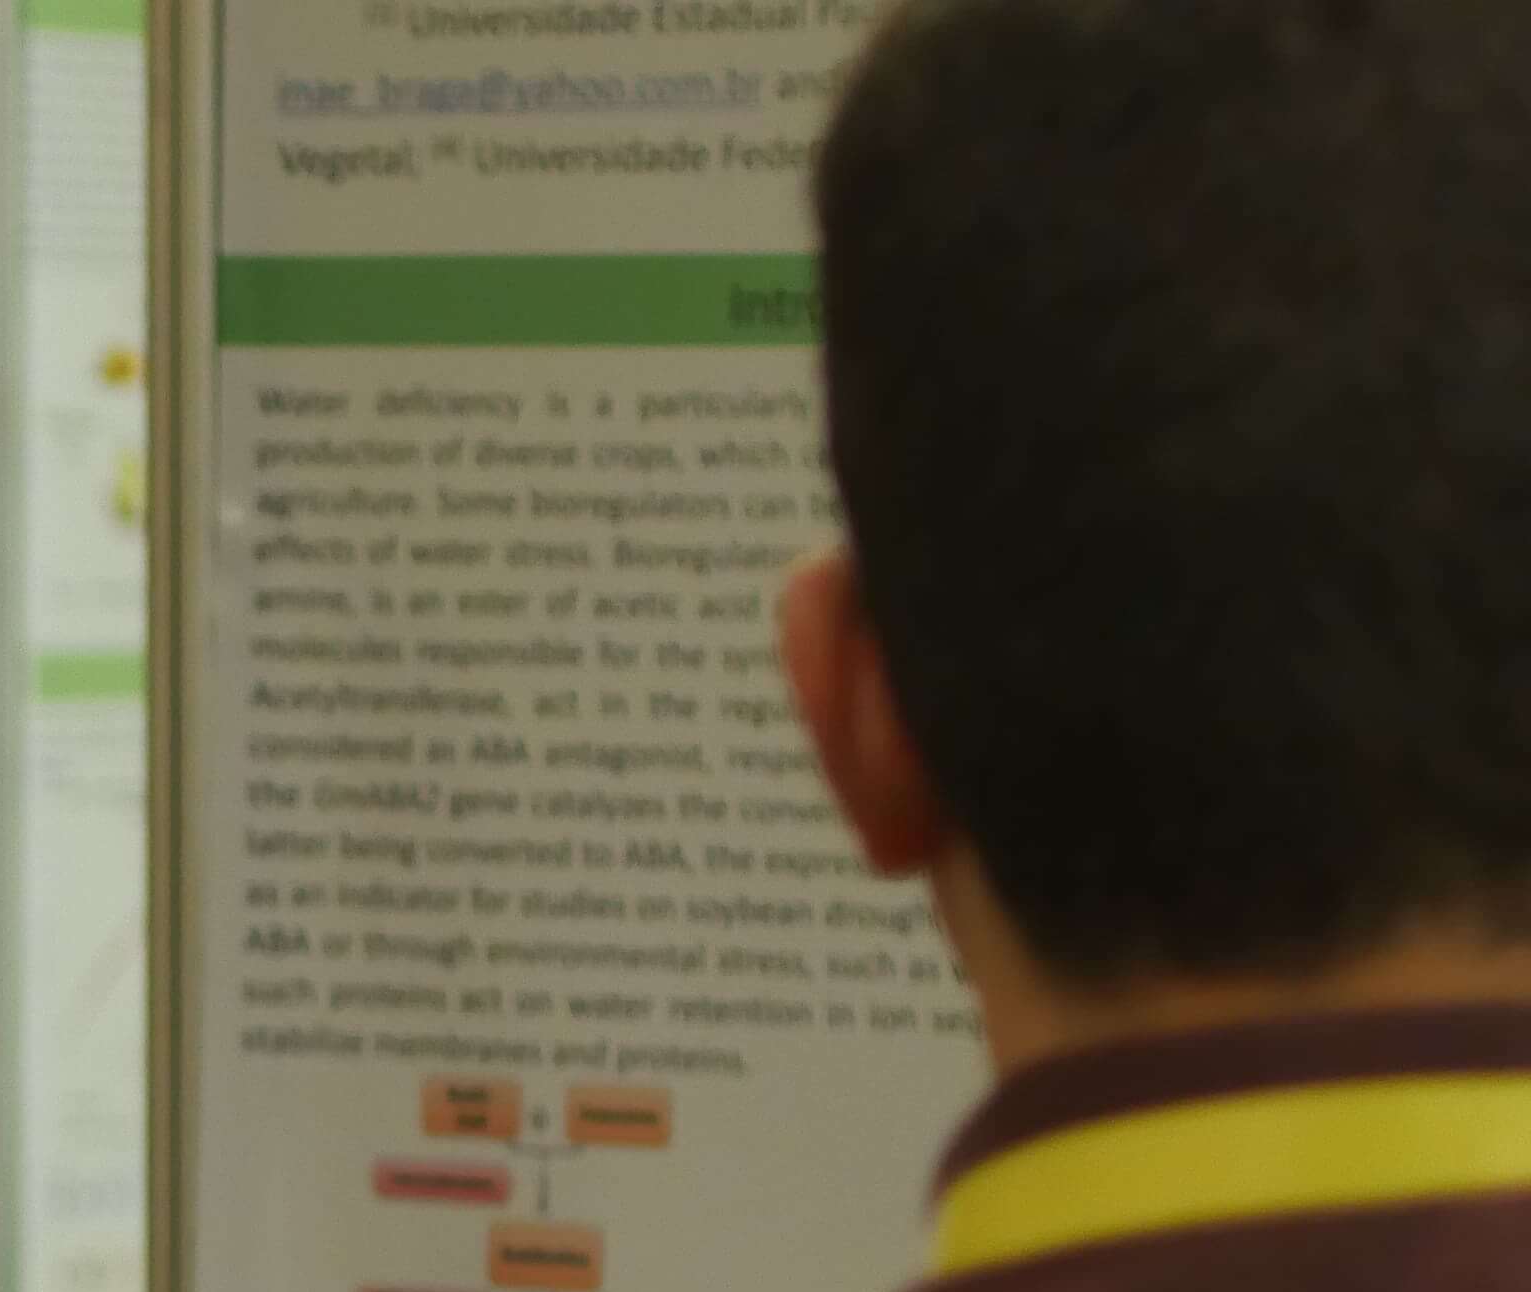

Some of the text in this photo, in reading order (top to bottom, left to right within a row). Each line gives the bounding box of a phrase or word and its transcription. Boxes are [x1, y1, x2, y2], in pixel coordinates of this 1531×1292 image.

[723, 134, 811, 172] Fede
[729, 286, 823, 328] Intr
[720, 647, 779, 678] syn
[718, 696, 787, 727] regu
[738, 798, 831, 824] conve
[763, 851, 854, 884] expre
[822, 896, 930, 938] drough
[930, 1008, 983, 1040] seq
